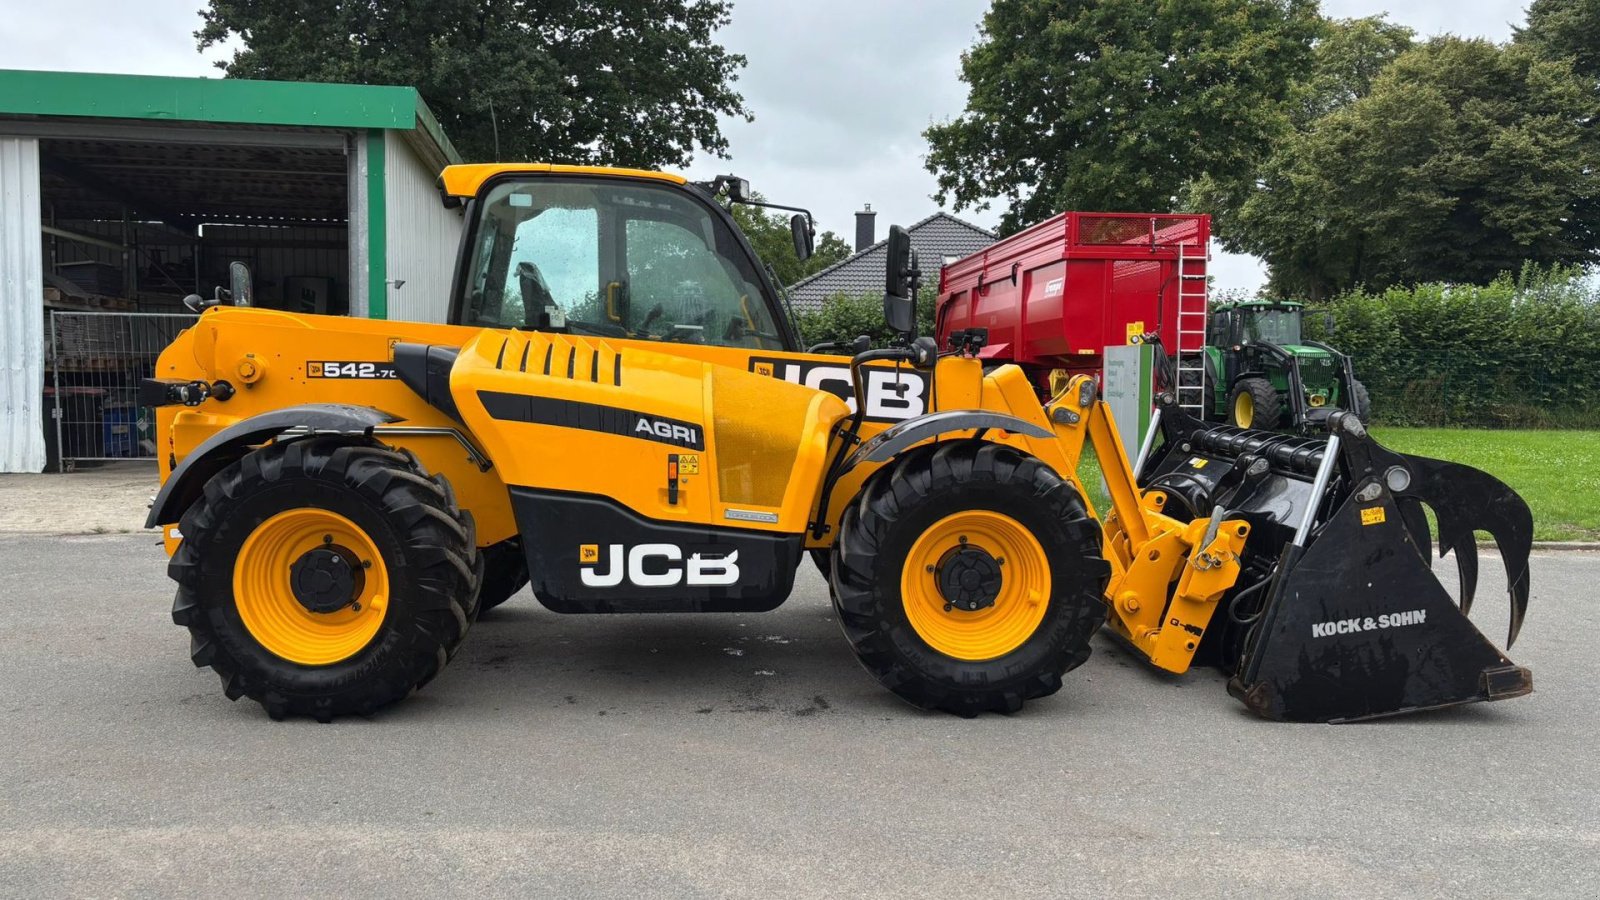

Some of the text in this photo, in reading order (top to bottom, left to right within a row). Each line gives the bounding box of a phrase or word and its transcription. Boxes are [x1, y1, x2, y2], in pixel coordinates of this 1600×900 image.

[784, 364, 925, 419] CB
[635, 418, 697, 443] AGRI
[581, 543, 740, 587] JCB
[1312, 609, 1426, 638] KOCK & SOHN
